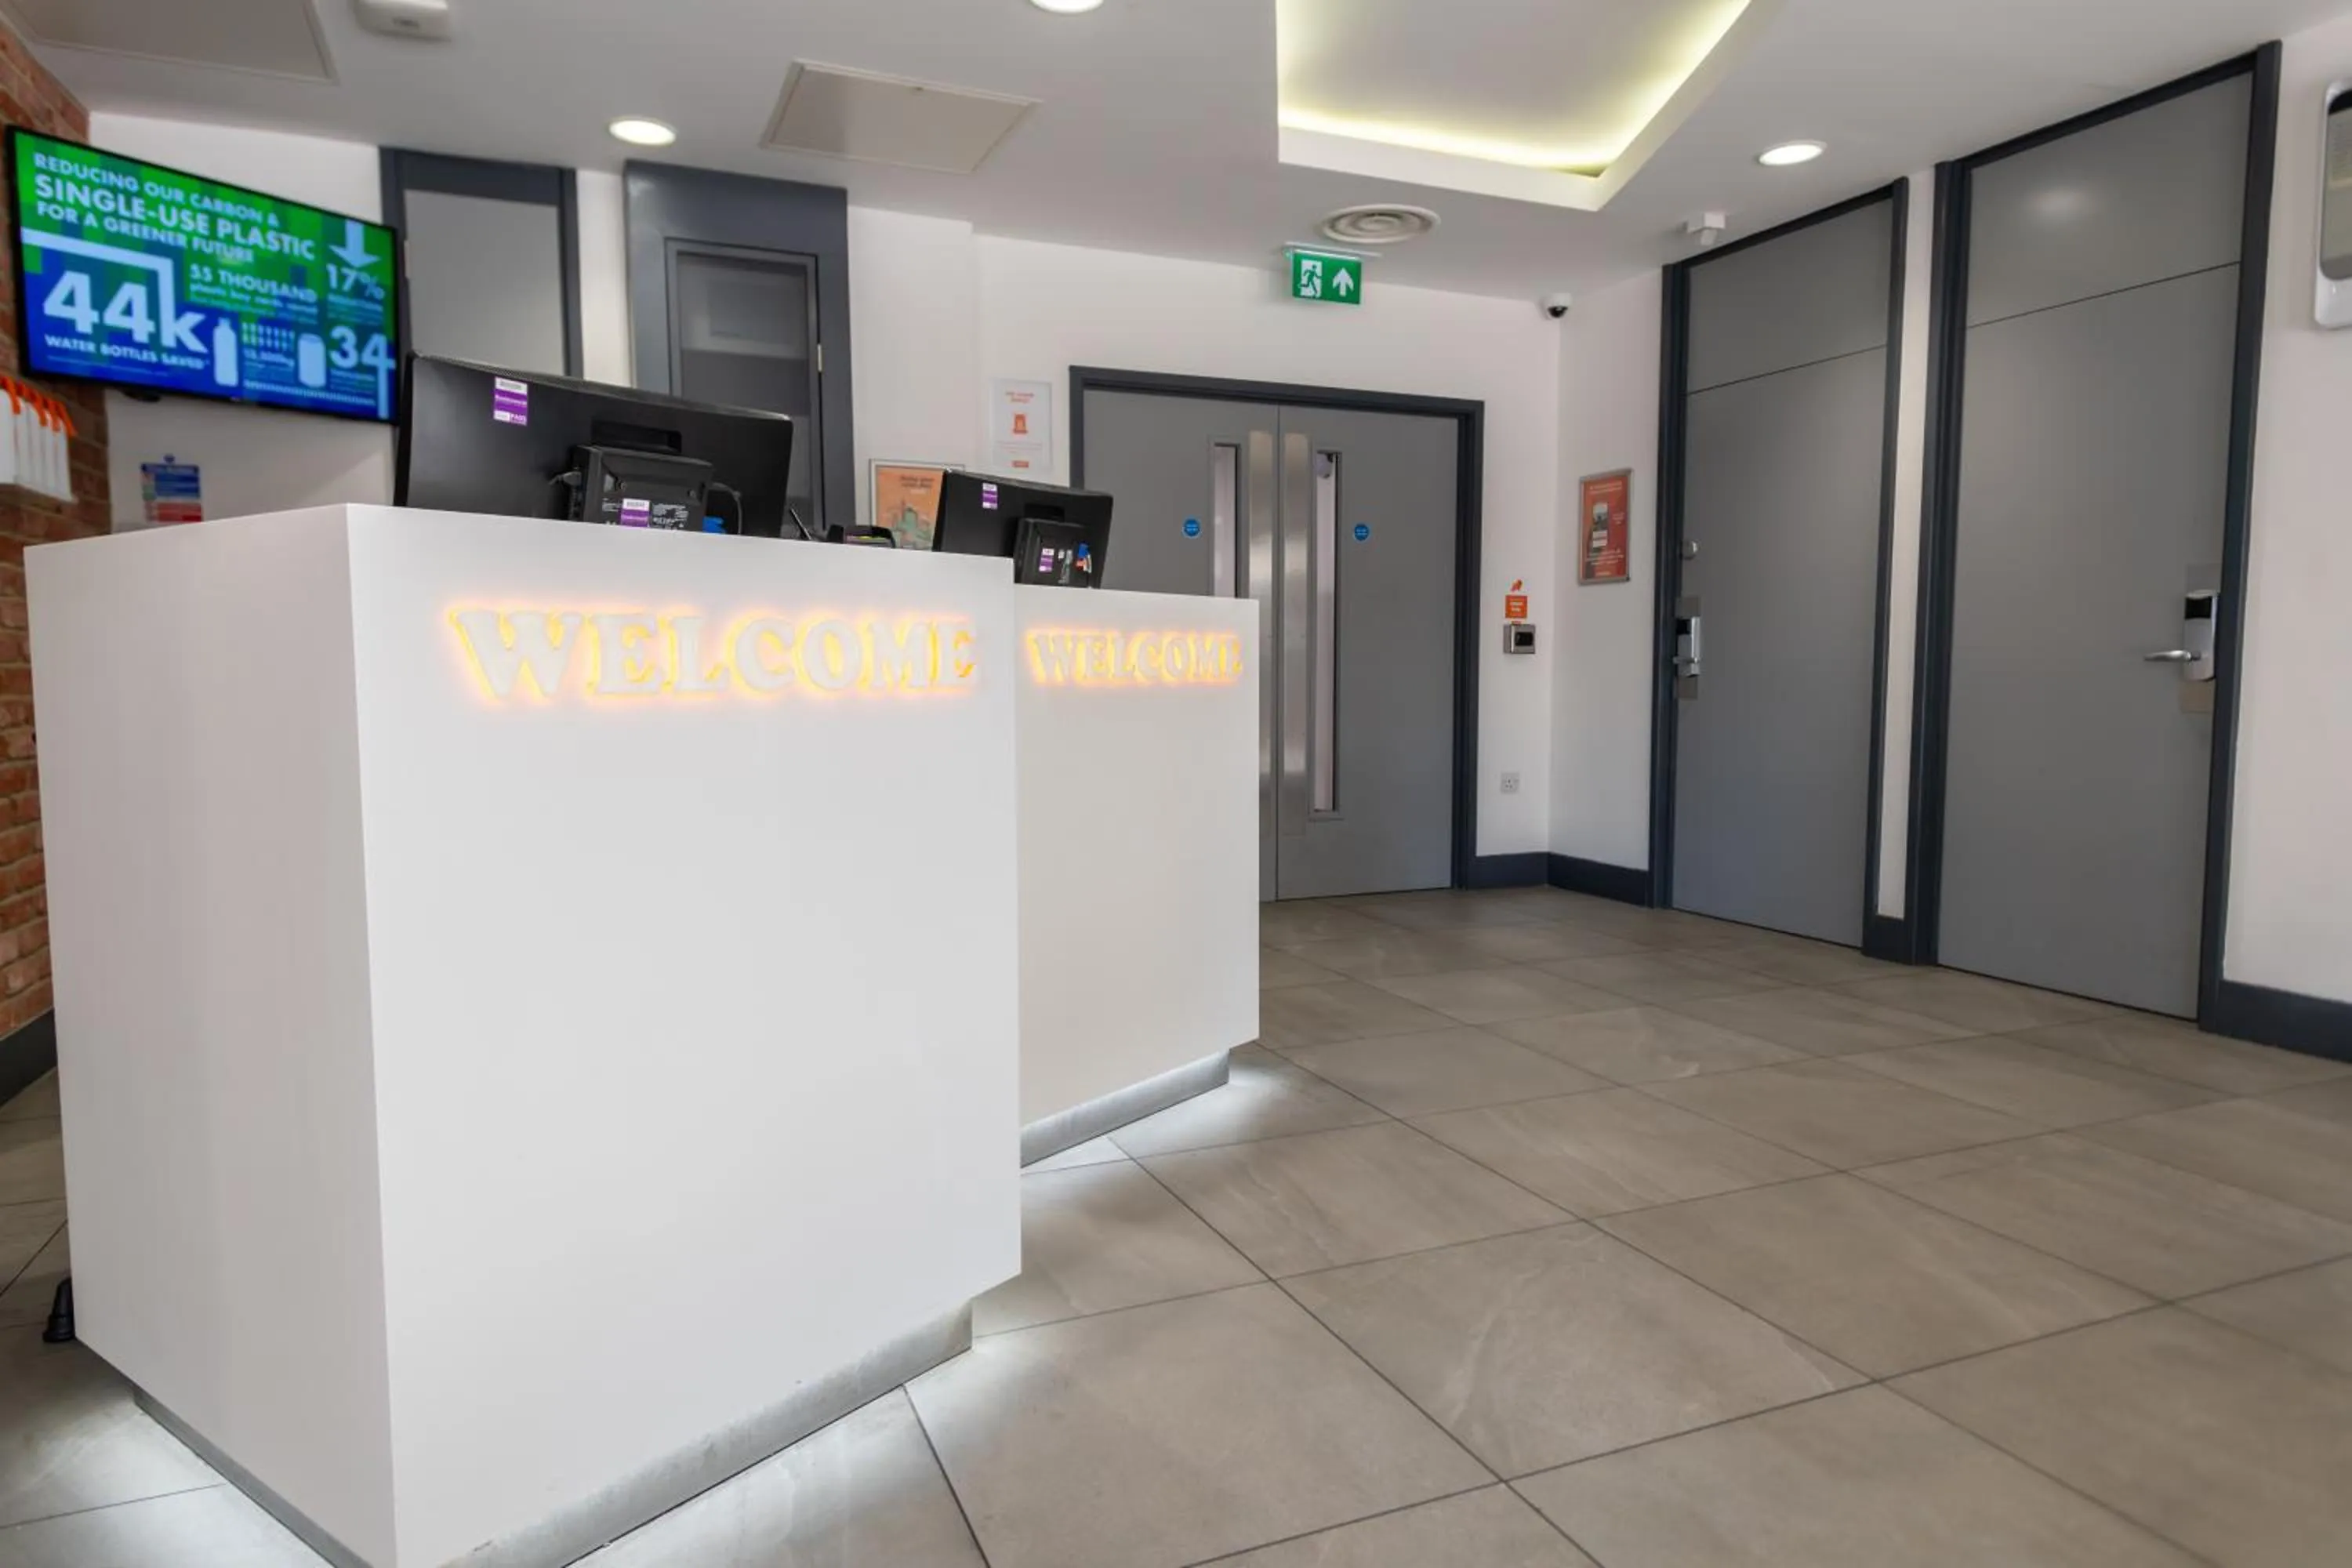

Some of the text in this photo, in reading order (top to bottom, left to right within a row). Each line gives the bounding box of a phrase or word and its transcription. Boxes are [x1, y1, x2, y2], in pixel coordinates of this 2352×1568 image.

[34, 152, 139, 192] REDUCING
[144, 181, 185, 205] OUR
[190, 193, 263, 223] CARBON
[34, 173, 315, 261] SINGLE-USE PLASTIC
[38, 200, 254, 263] FOR A GREENER FUTURE
[217, 269, 318, 303] THOUSAND
[326, 263, 387, 301] 17%
[44, 332, 96, 354] WATER
[100, 343, 159, 363] BOTTLES
[450, 608, 978, 698] WELCOME
[1027, 630, 1243, 683] WELCOME
